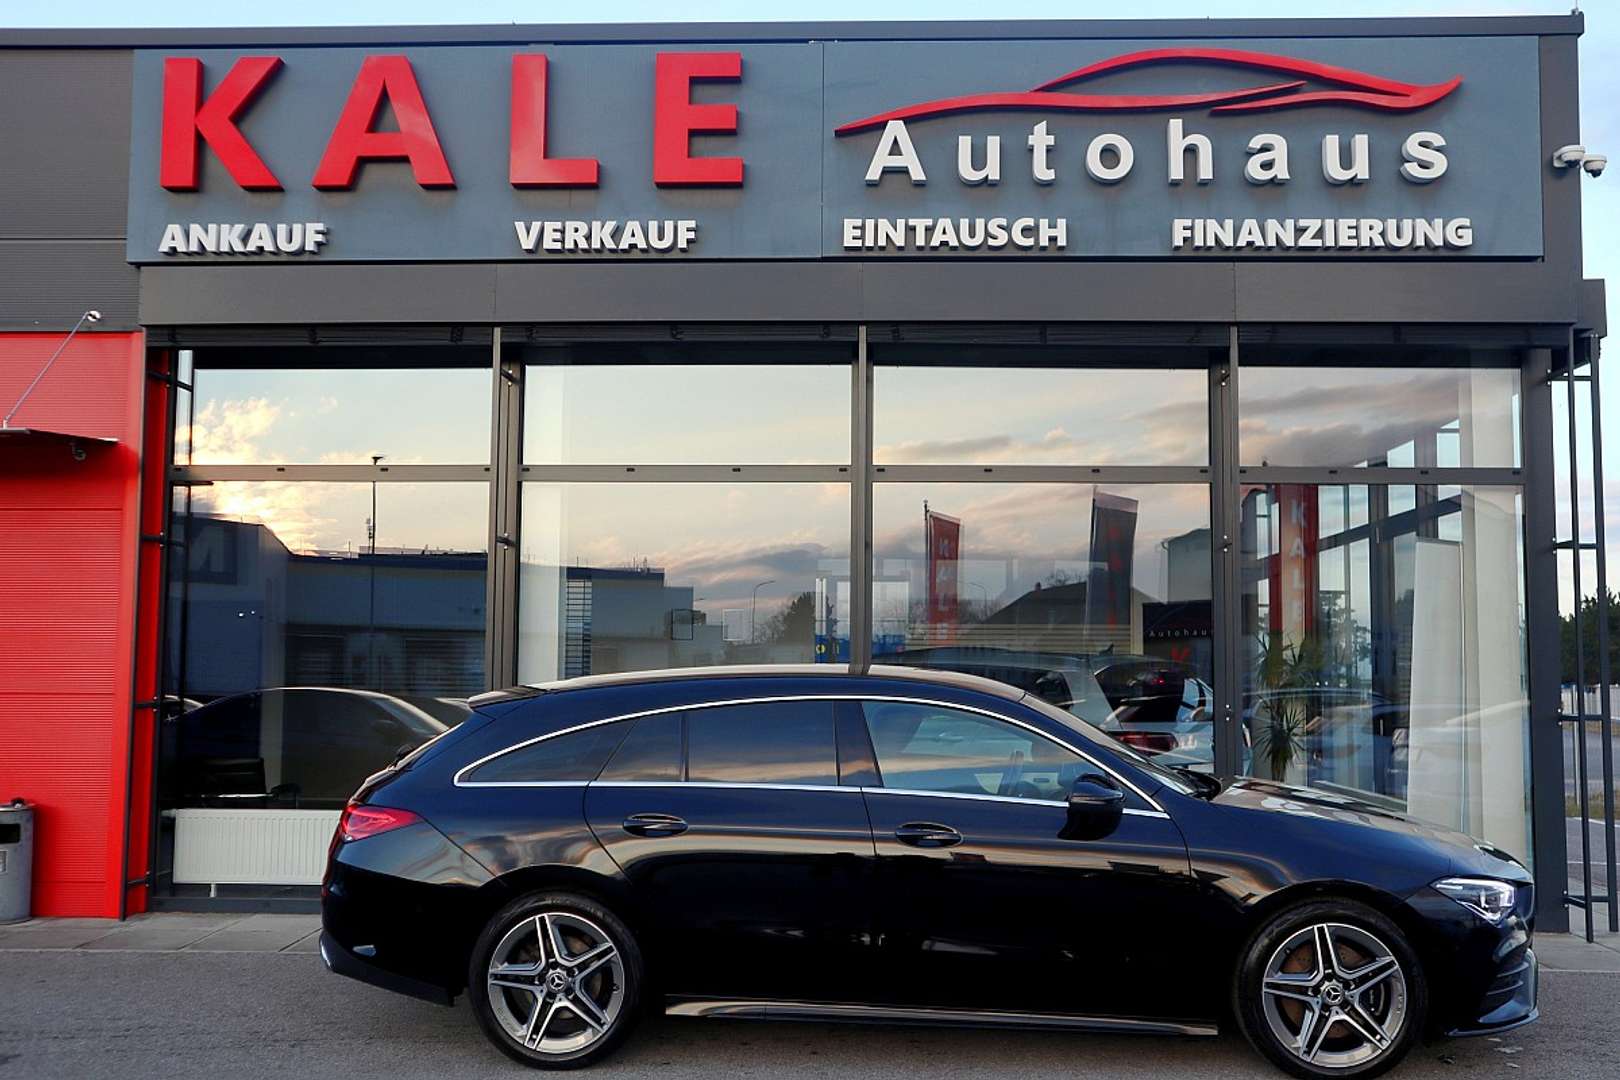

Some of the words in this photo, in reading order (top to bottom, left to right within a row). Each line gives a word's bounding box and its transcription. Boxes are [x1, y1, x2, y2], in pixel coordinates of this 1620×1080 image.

[160, 52, 745, 191] KALE
[864, 117, 1449, 186] Autohaus
[158, 222, 328, 255] ANKAUF
[514, 219, 698, 253] VERKAUF
[842, 217, 1068, 250] EINTAUSCH
[1171, 217, 1474, 250] FINANZIERUNG
[1149, 628, 1214, 638] Autohau
